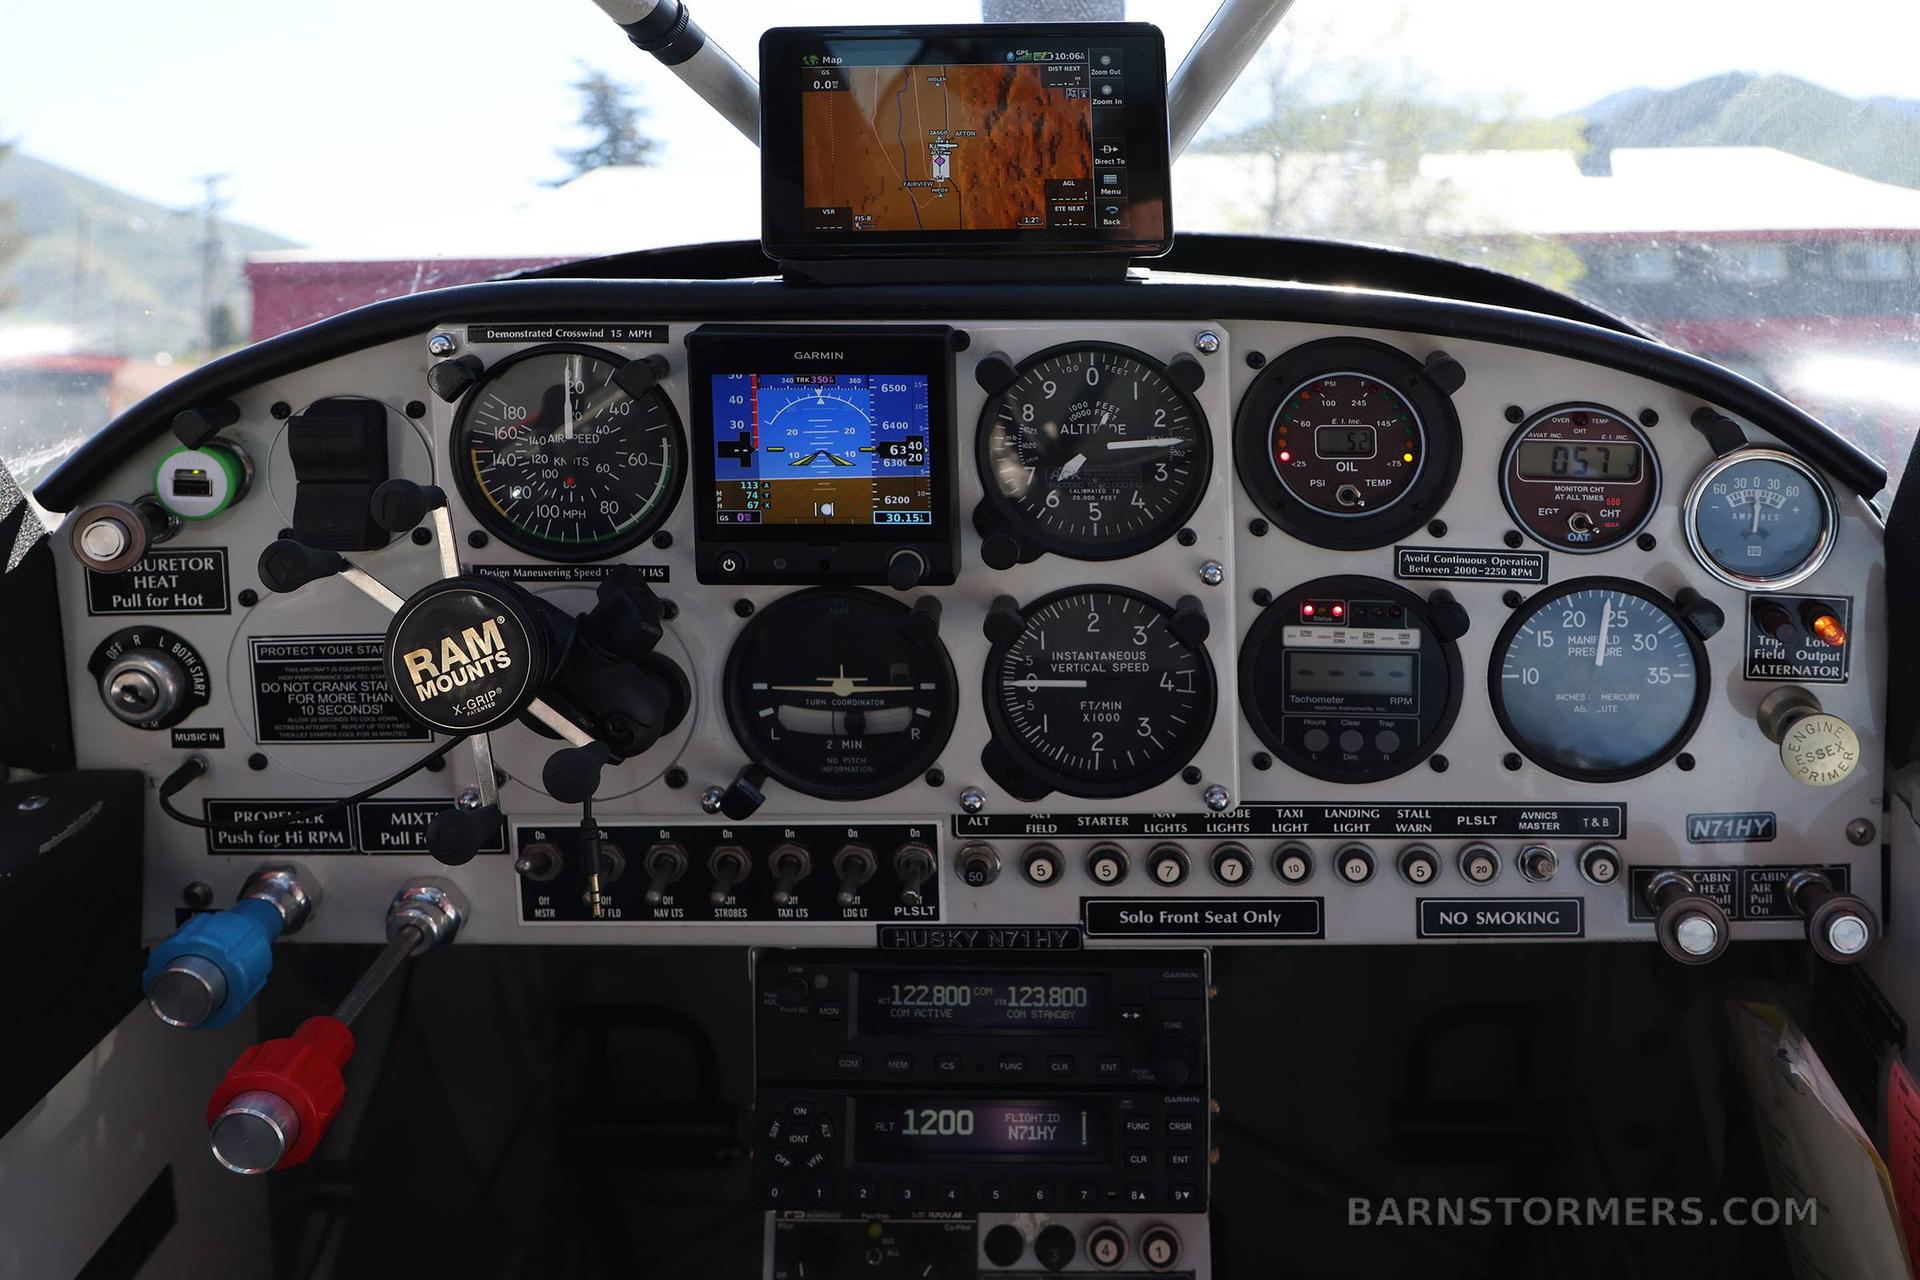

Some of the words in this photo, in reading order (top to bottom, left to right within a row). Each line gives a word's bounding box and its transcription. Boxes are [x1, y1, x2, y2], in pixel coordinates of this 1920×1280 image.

[822, 56, 842, 65] Map
[487, 329, 552, 338] Demonstrated
[556, 329, 603, 338] Crosswind
[882, 384, 906, 392] 6500
[883, 422, 908, 430] 6400
[1551, 446, 1610, 474] 057
[1336, 462, 1358, 472] OIL
[885, 496, 910, 504] 6200
[563, 510, 586, 518] MPH
[886, 514, 918, 522] 30.15
[1568, 533, 1590, 541] OAT
[1404, 555, 1429, 563] Avoid
[1434, 555, 1487, 564] Continuous
[1492, 557, 1539, 567] Operation
[1409, 565, 1449, 574] Between
[1455, 567, 1507, 576] 2000-2250
[1511, 568, 1532, 576] RPM
[134, 576, 178, 588] HEAT
[113, 594, 142, 607] Pull
[147, 595, 168, 606] for
[173, 594, 203, 606] Hot
[1562, 611, 1585, 627] 20
[1537, 631, 1553, 647] 15
[1632, 635, 1657, 650] 30
[172, 643, 196, 666] BOTH
[261, 647, 315, 656] PROTECT
[320, 646, 352, 655] YOUR
[1754, 651, 1785, 659] Field
[1052, 652, 1146, 661] INSTANTANEOUS
[1796, 651, 1840, 662] Output
[1051, 663, 1106, 672] VERTICAL
[1112, 663, 1149, 672] SPEED
[1752, 665, 1839, 676] ALTERNATOR
[416, 651, 511, 702] MOUNTS
[1523, 668, 1539, 684] 10
[1647, 668, 1670, 683] 35
[190, 666, 205, 697] START
[262, 683, 280, 693] DO
[284, 682, 309, 692] NOT
[313, 682, 356, 692] CRANK
[288, 694, 315, 704] FOR
[318, 693, 356, 703] MORE
[359, 693, 393, 703] THAN
[1291, 696, 1344, 704] Tachometer
[1390, 697, 1412, 705] RPM
[452, 690, 497, 717] X-GRIP
[1081, 702, 1122, 710] FT/MIN
[302, 706, 314, 715] 10
[318, 704, 383, 715] SECONDS!
[467, 702, 496, 717] PATENTED
[175, 733, 206, 741] MUSIC
[1789, 721, 1845, 752] ENGINE
[1796, 742, 1845, 765] ESSEX
[1799, 751, 1853, 781] PRIMER
[1277, 810, 1303, 818] TAXI
[1325, 810, 1379, 818] LANDING
[1397, 810, 1431, 819] STALL
[1521, 812, 1558, 820] AVNICS
[968, 817, 990, 826] ALT
[1078, 817, 1129, 826] STARTER
[1457, 816, 1497, 825] PLSLT
[1026, 824, 1057, 833] FIELD
[1144, 824, 1187, 833] LIGHTS
[1207, 824, 1249, 832] LIGHTS
[1272, 824, 1309, 832] LIGHT
[1334, 824, 1371, 832] LIGHT
[1396, 824, 1432, 832] WARN
[1519, 822, 1560, 830] MASTER
[1694, 819, 1770, 837] N71HY
[218, 831, 252, 844] Push
[259, 832, 279, 844] for
[285, 831, 303, 844] Hi
[308, 831, 344, 843] RPM
[381, 832, 410, 845] Pull
[1693, 873, 1731, 882] CABIN
[1751, 873, 1789, 881] CABIN
[1700, 884, 1730, 893] HEAT
[1751, 884, 1771, 893] AIR
[1751, 894, 1772, 903] Pull
[535, 909, 555, 917] MSTR
[654, 909, 669, 917] NAV
[671, 909, 683, 917] LTS
[715, 909, 747, 918] STROBES
[778, 909, 793, 917] TAXI
[796, 909, 808, 917] LTS
[894, 907, 935, 916] PLSLT
[1751, 905, 1769, 914] On
[1120, 910, 1153, 924] Solo
[1160, 911, 1198, 924] Front
[1205, 911, 1238, 924] Seat
[1244, 910, 1281, 927] Only
[1440, 912, 1468, 925] NO
[1477, 912, 1559, 925] SMOKING
[895, 930, 979, 947] HUSKY
[990, 930, 1069, 946] N71HY
[892, 985, 970, 1006] 122.800
[1008, 987, 1087, 1007] 123.800
[891, 1009, 910, 1017] COM
[915, 1009, 952, 1018] ACTIVE
[1007, 1010, 1026, 1019] COM
[1032, 1010, 1075, 1019] STANDBY
[903, 1110, 973, 1135] 1200
[1005, 1114, 1042, 1123] FLIGHT
[1048, 1114, 1060, 1123] ID
[1008, 1126, 1055, 1140] N71HY
